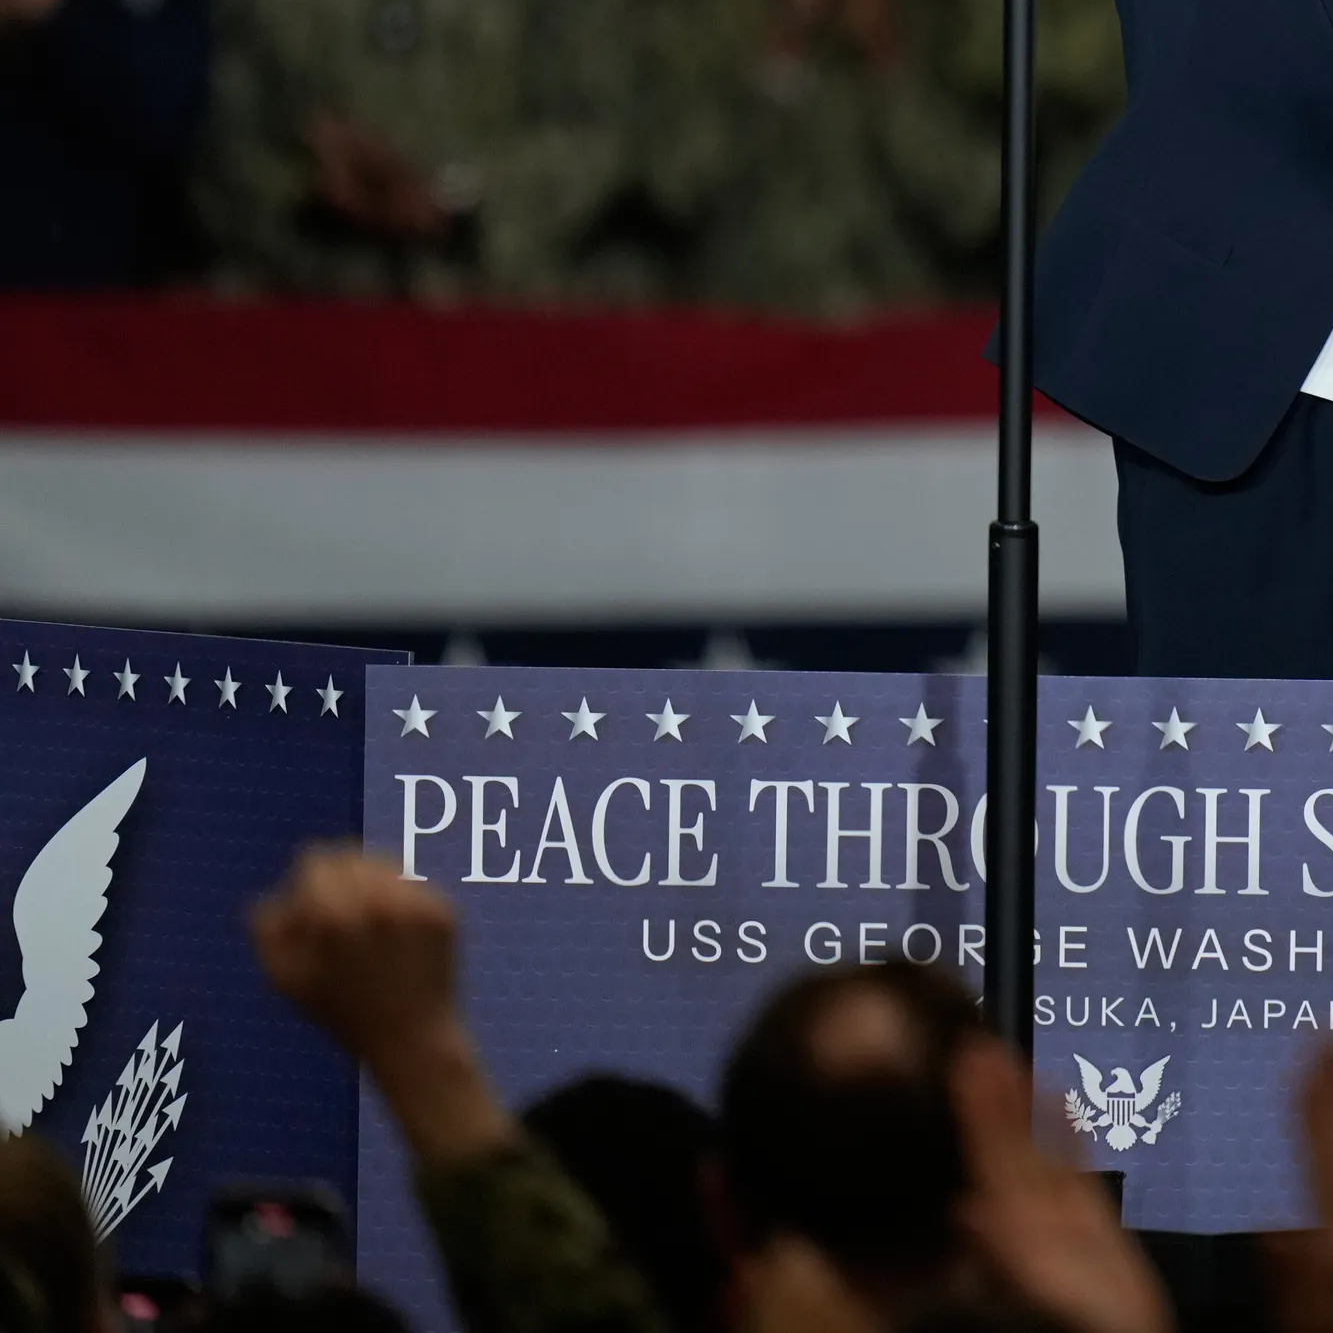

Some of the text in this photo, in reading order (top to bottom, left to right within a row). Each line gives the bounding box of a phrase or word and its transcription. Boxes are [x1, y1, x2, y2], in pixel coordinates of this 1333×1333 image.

[395, 774, 719, 886] PEACE
[642, 919, 767, 964] USS
[804, 921, 1088, 969] GEORE
[975, 994, 1178, 1033] SUKA,
